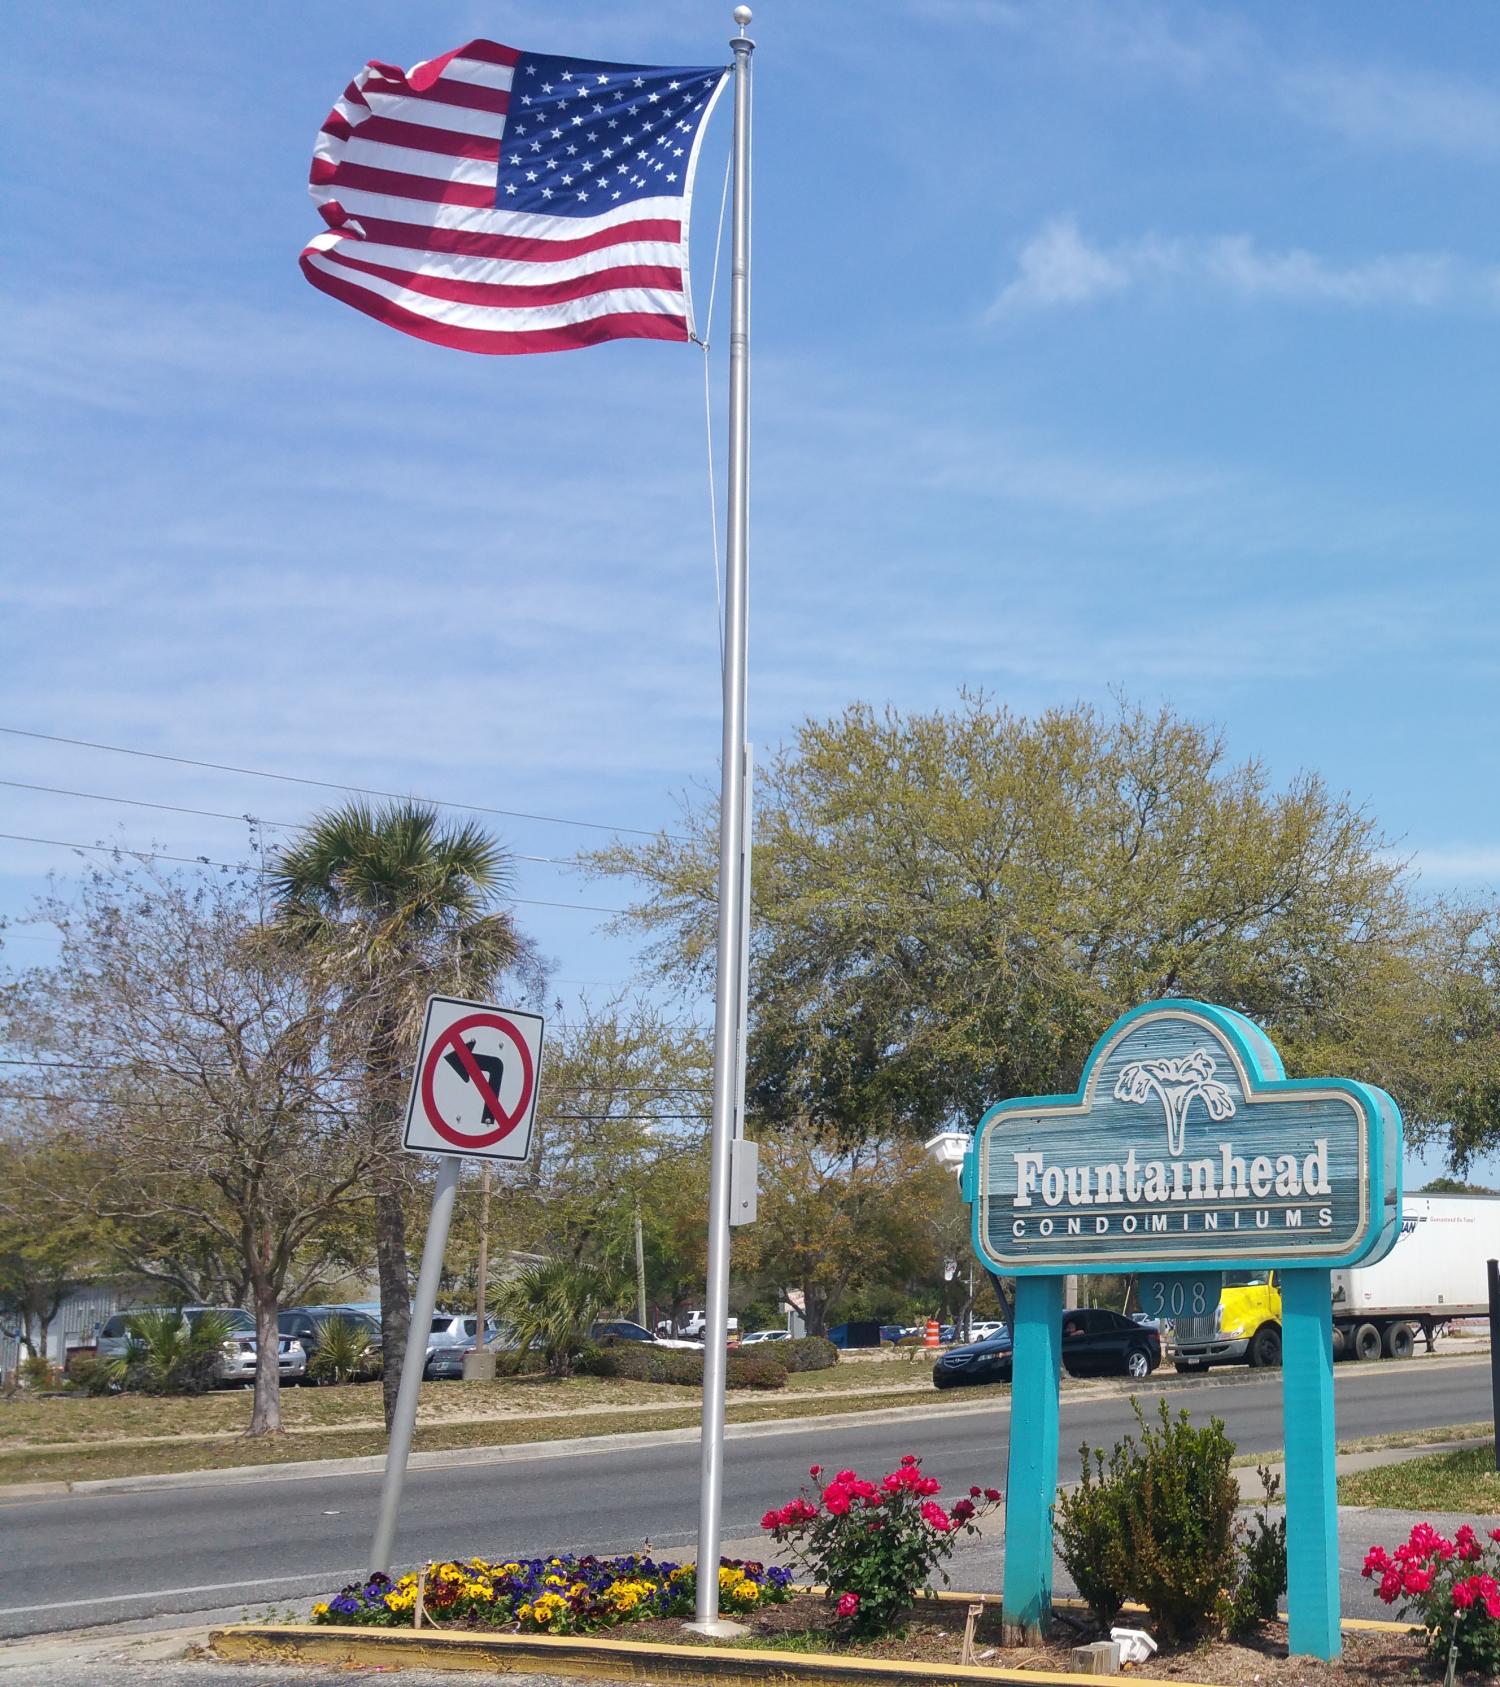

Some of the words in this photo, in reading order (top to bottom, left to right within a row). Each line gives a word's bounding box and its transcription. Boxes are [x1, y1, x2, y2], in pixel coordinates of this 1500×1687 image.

[1012, 1138, 1332, 1207] Fountainhead
[1012, 1207, 1333, 1238] CONDOMINIUMS
[1152, 1280, 1207, 1316] 308
